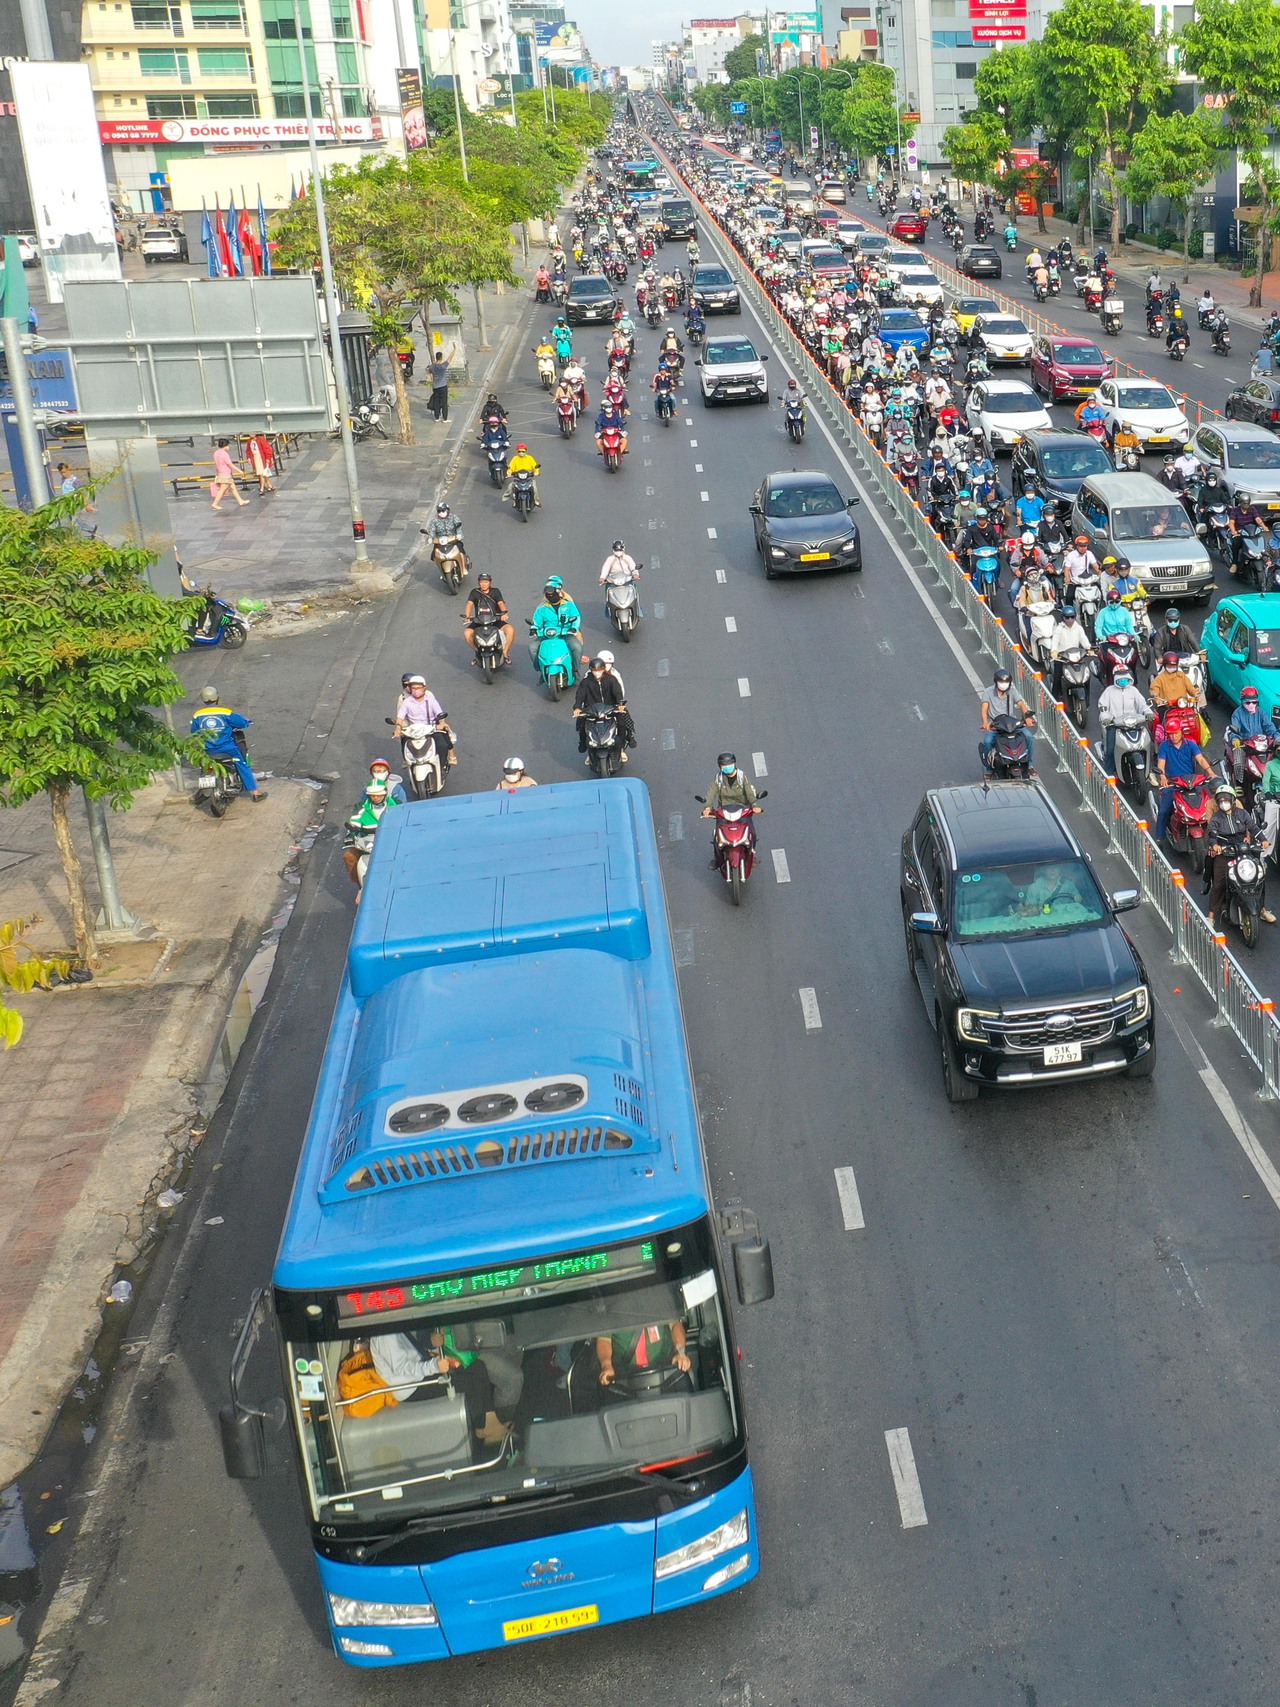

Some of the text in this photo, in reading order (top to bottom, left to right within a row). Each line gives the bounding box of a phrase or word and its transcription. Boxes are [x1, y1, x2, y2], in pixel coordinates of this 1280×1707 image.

[233, 125, 271, 138] PHỤC
[1054, 1046, 1070, 1055] 51K
[1048, 1053, 1078, 1064] 477.97
